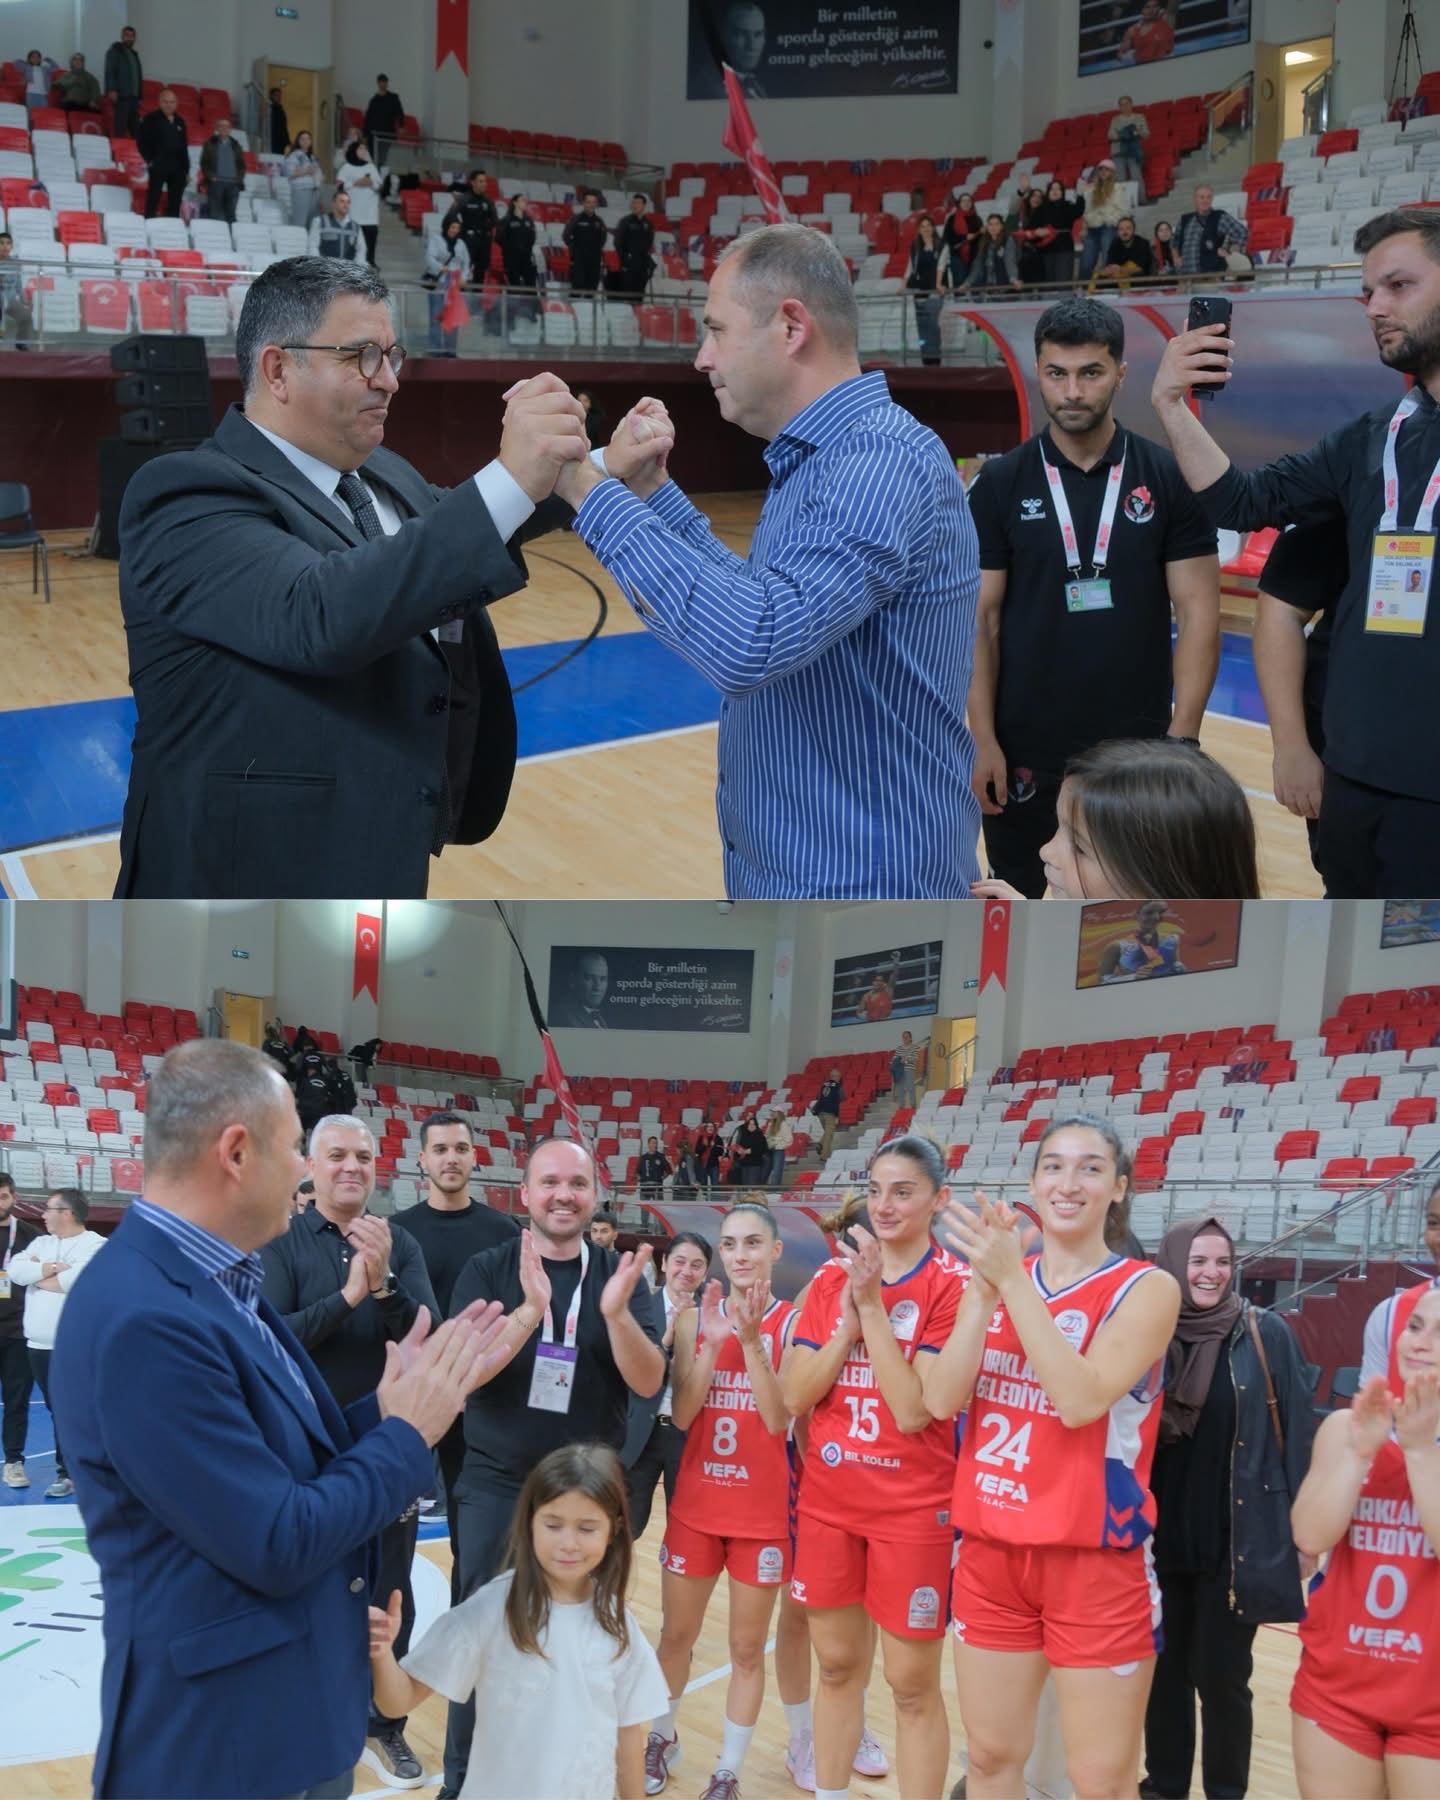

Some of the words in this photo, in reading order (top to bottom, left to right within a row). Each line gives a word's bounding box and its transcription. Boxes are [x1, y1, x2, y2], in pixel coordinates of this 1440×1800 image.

[817, 8, 838, 23] Bir
[843, 6, 897, 22] milletin
[777, 28, 825, 48] sporda
[828, 26, 899, 47] gösterdiği
[903, 25, 939, 40] azim
[768, 53, 805, 65] onun
[808, 48, 878, 68] geleceğini
[648, 962, 663, 974] Bir
[666, 961, 707, 974] milletin
[616, 976, 653, 991] sporda
[655, 978, 708, 992] gösterdiği
[710, 980, 737, 990] azim
[609, 995, 638, 1004] onun
[640, 992, 692, 1008] geleceğini
[844, 1395, 880, 1442] 15
[713, 1416, 737, 1456] 8
[975, 1412, 1033, 1473] 24
[703, 1461, 750, 1480] VEFA
[1365, 1564, 1408, 1620] 0
[1348, 1623, 1423, 1655] VEFA
